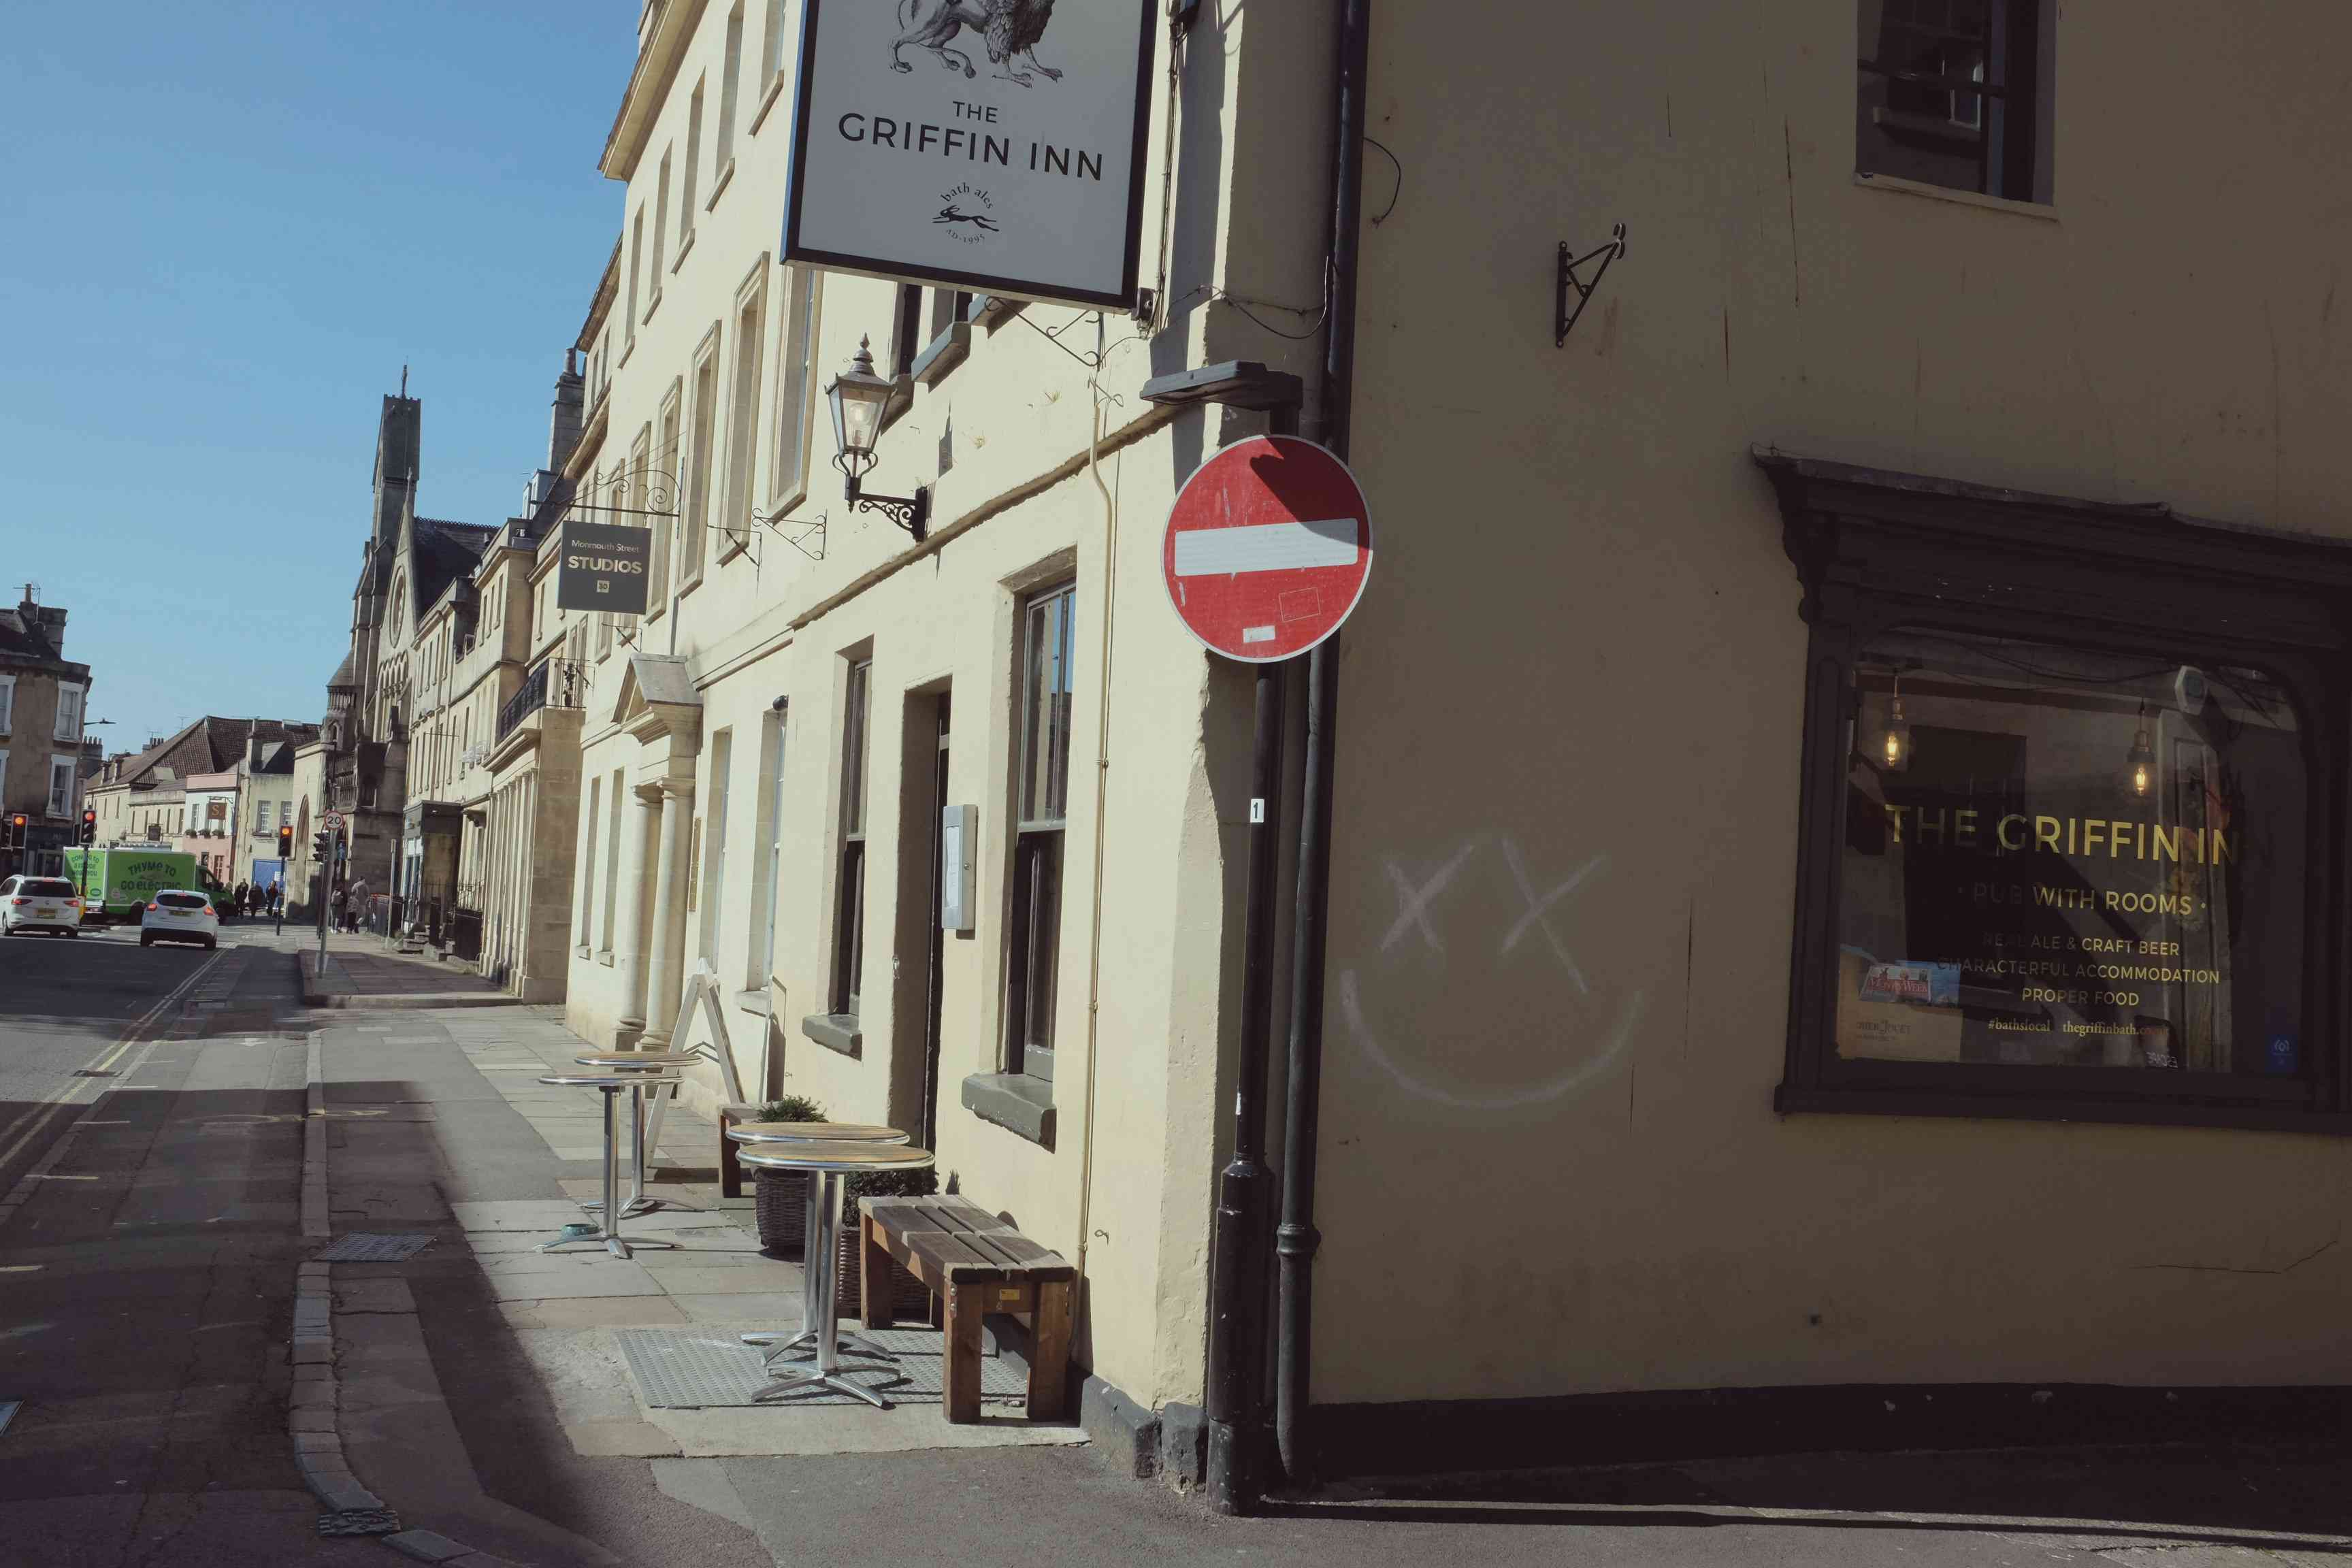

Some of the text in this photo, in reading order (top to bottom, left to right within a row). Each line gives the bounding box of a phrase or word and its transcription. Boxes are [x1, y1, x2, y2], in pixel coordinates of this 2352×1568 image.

[953, 101, 998, 123] THE
[838, 113, 1102, 181] GRIFFIN INN
[941, 182, 994, 208] bath ales
[572, 540, 640, 553] Monmouth Street
[568, 555, 642, 574] STUDIOS
[599, 582, 608, 590] 30
[1253, 802, 1258, 819] 1
[327, 816, 342, 825] 20
[1884, 804, 1978, 847] THE
[1997, 813, 2179, 862] GRIFFIN
[165, 864, 176, 877] TO
[120, 881, 135, 890] GO
[2032, 885, 2095, 910] WITH
[2106, 890, 2193, 915] ROOMS
[2031, 933, 2061, 949] ALE
[2067, 936, 2076, 950] &
[2081, 937, 2134, 953] CRAFT
[2139, 941, 2179, 956] BEER
[1938, 958, 2220, 984] CHARACTERFUL ACCOMMODATION
[2021, 987, 2140, 1006] PROPER FOOD
[1988, 1017, 2051, 1032] #bathslocal
